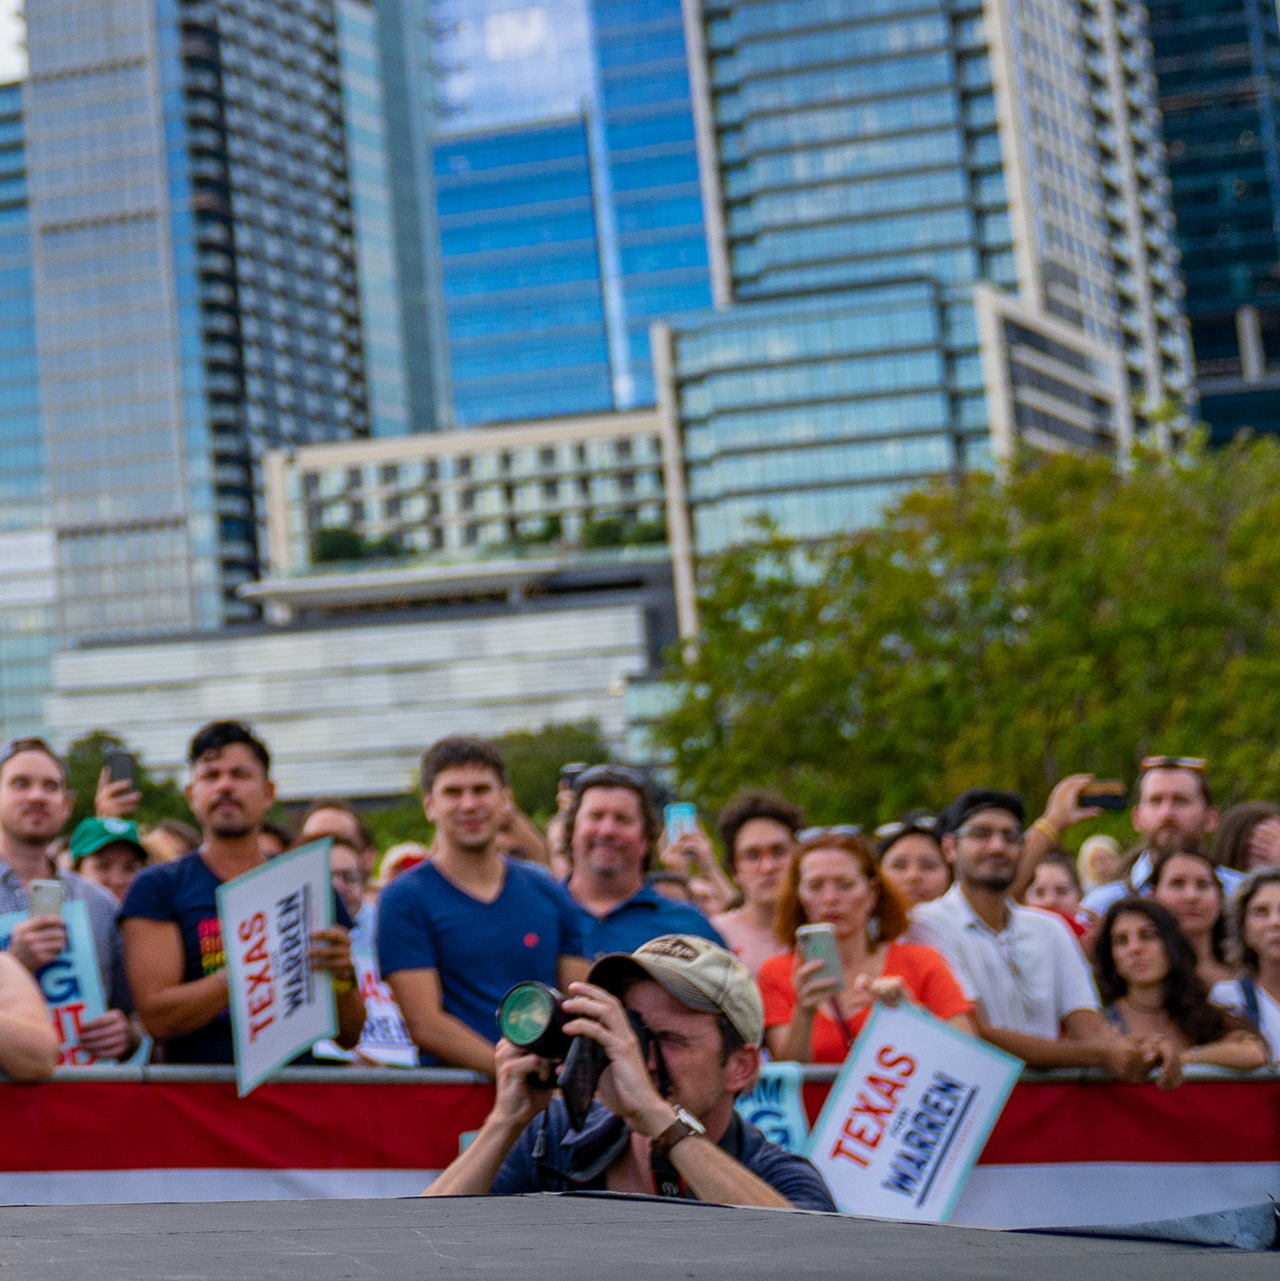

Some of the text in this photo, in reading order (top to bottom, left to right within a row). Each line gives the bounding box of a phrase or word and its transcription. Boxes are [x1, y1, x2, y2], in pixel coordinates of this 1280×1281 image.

[239, 910, 275, 1043] TEXAS
[276, 890, 305, 1020] WARREN
[829, 1044, 918, 1168] TEXAS
[881, 1071, 967, 1197] WARREN
